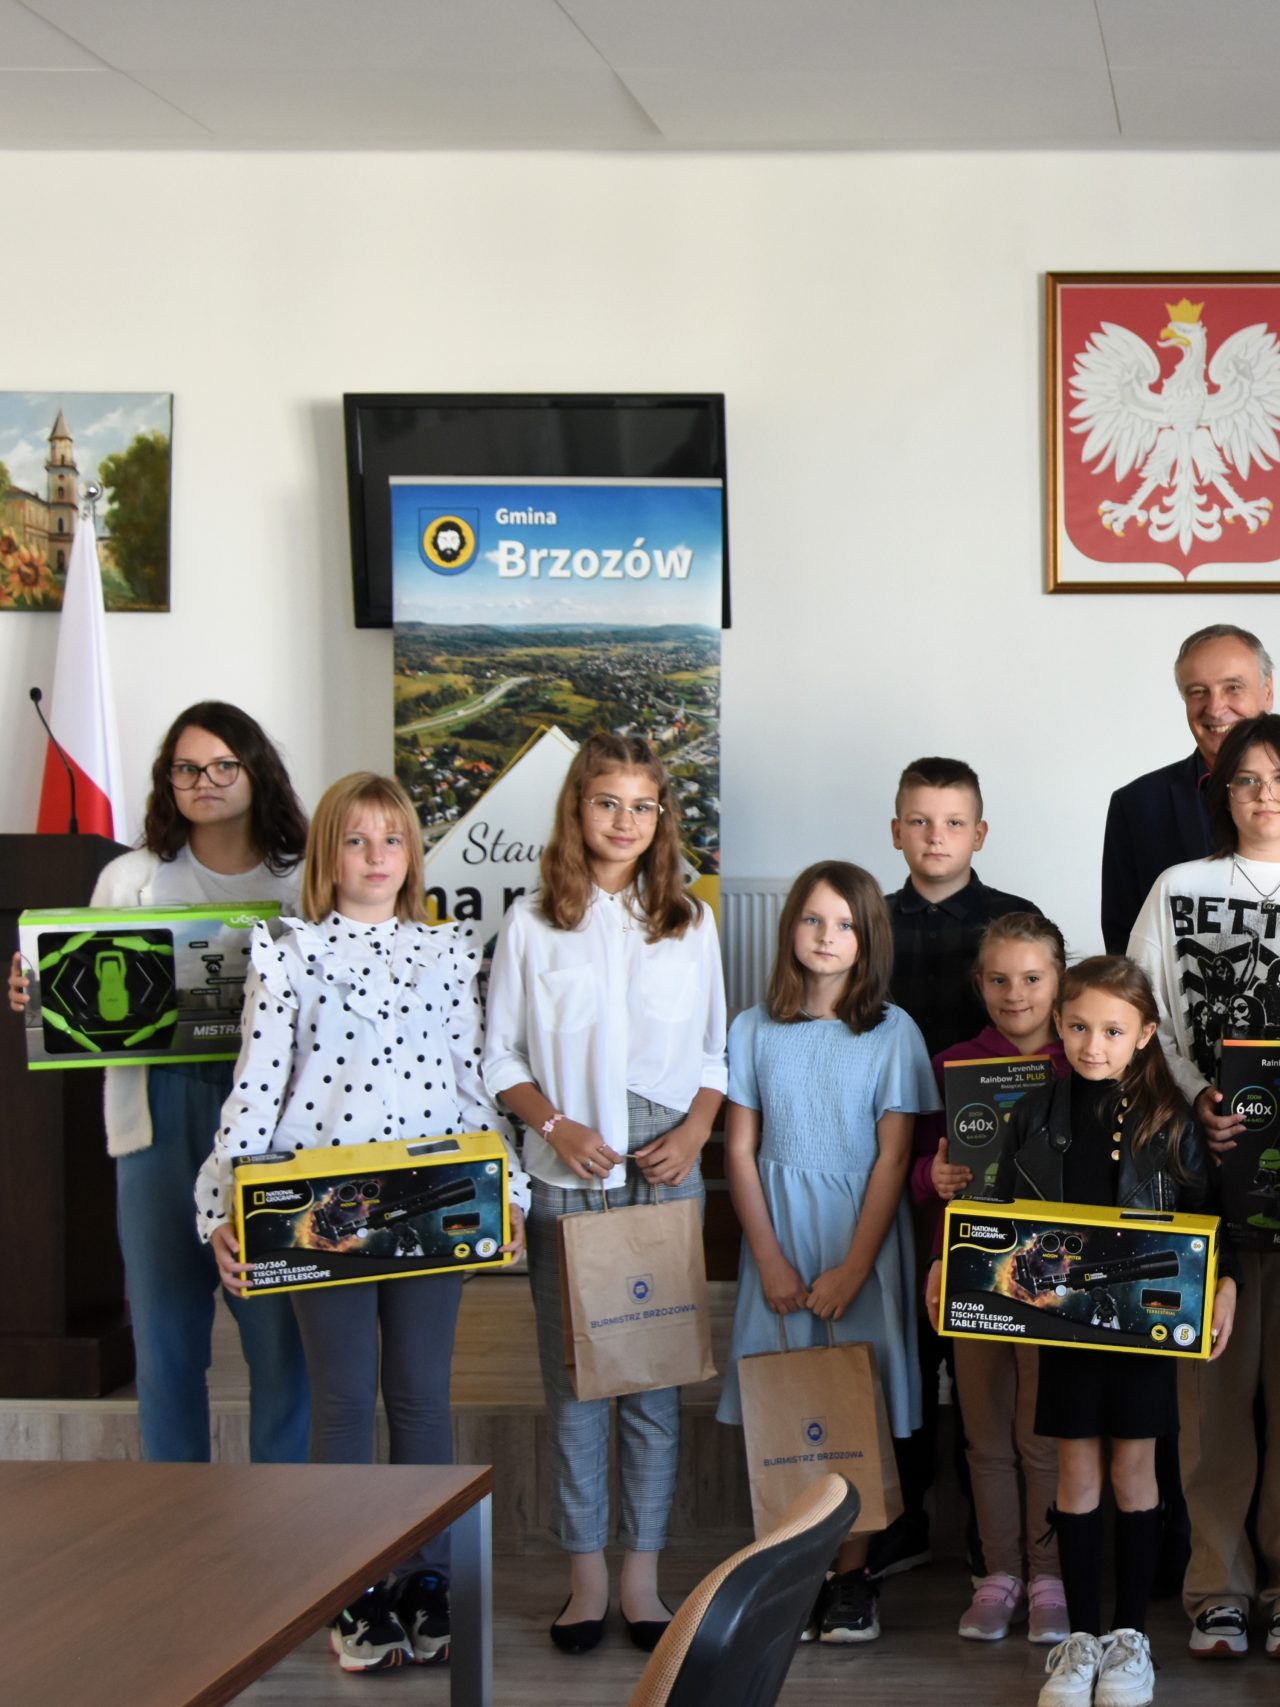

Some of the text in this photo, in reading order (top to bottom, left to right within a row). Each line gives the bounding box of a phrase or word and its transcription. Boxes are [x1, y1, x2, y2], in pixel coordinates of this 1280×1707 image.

[495, 507, 557, 525] Gmina
[498, 537, 694, 580] Brzozów
[193, 1023, 242, 1036] MISTRA
[1008, 1064, 1045, 1073] Levenhuk
[980, 1076, 1013, 1084] Rainbow
[1026, 1073, 1046, 1081] PLUS
[1236, 1102, 1272, 1115] 640x
[959, 1118, 994, 1133] 640x
[970, 1231, 1006, 1240] GEOGRAPHIC
[971, 1225, 999, 1234] NATIONAL
[252, 1265, 318, 1278] TISCH-TELESKOP
[252, 1269, 331, 1287] TABLE TELESCOPE
[951, 1301, 985, 1312] 50/360
[590, 1303, 697, 1329] BURMISTRZ BRZOZOWA
[951, 1311, 1014, 1322] TISCH-TELESKOP
[951, 1318, 1026, 1333] TABLE TELESCOPE
[1180, 1329, 1189, 1340] 5
[763, 1451, 864, 1467] BURMISTRZ BRZOZOWA
